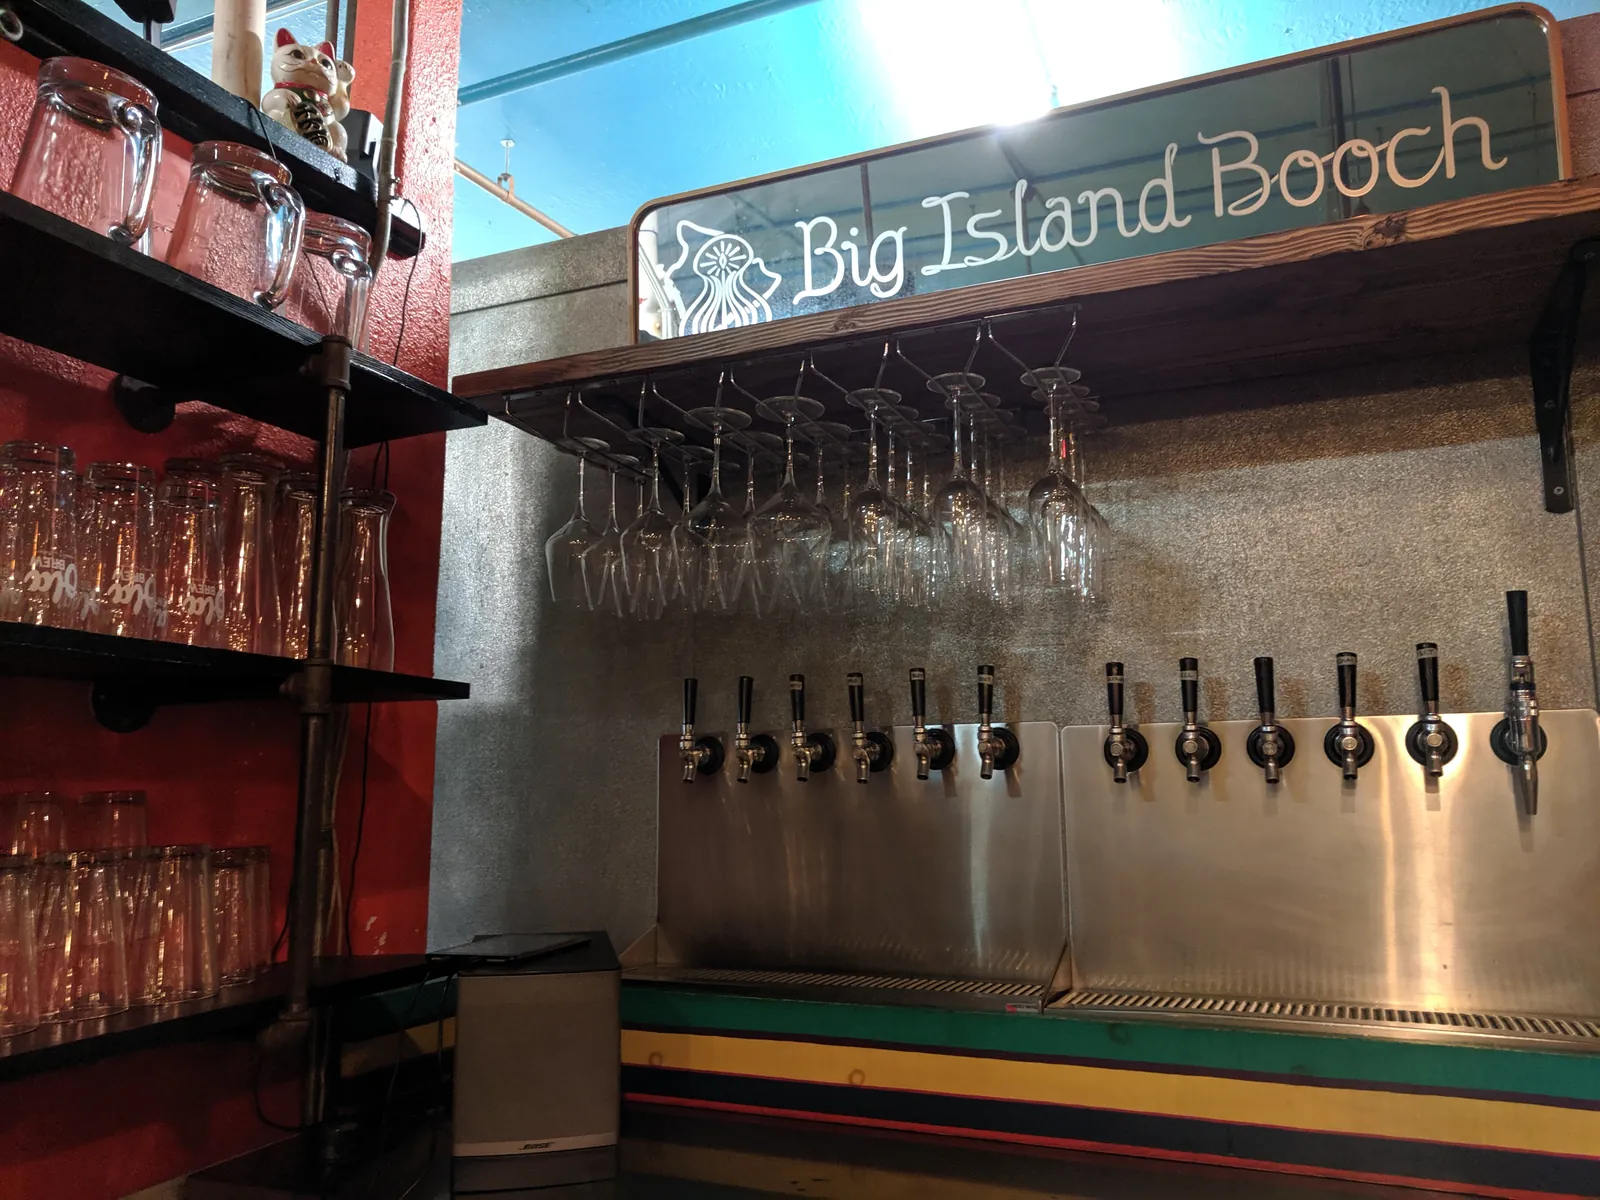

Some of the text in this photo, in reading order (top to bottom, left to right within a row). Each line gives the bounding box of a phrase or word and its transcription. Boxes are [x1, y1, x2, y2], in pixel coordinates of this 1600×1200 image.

[793, 86, 1508, 305] Big Island Booch
